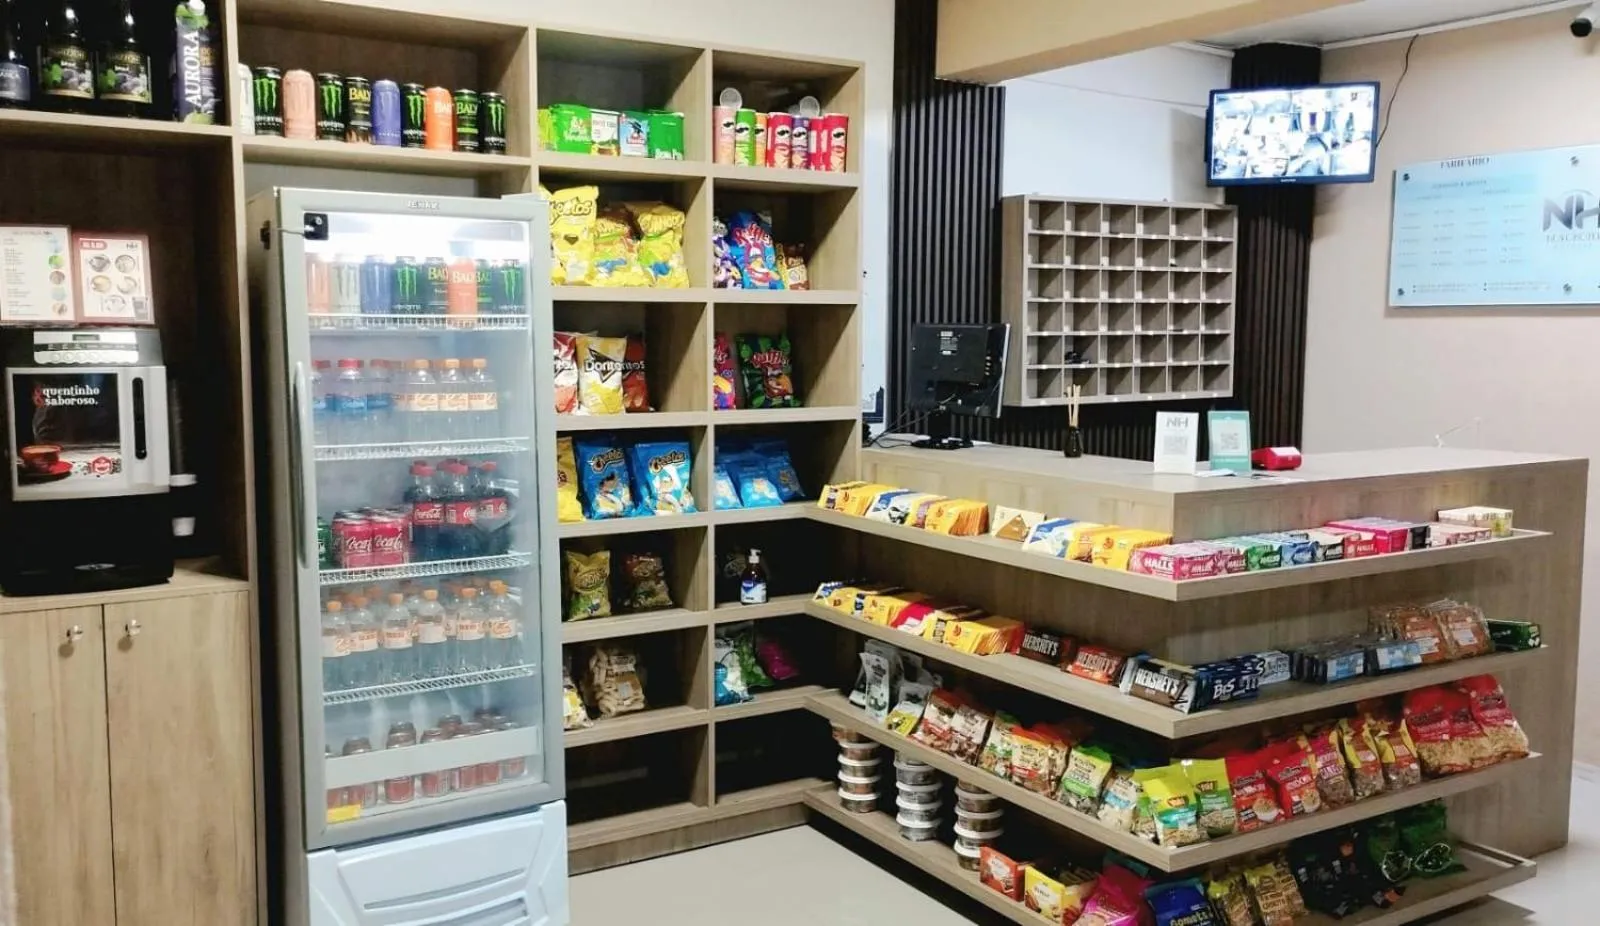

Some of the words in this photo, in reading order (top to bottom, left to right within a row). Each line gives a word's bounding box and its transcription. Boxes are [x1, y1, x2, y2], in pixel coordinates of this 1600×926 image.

[182, 31, 200, 107] AURORA
[456, 101, 478, 115] BALY
[42, 385, 100, 398] quentinho
[44, 396, 99, 406] saboroso.
[1166, 417, 1188, 428] NH
[1143, 556, 1174, 572] HALLS
[1022, 633, 1059, 656] HERSHEY'S
[1077, 651, 1118, 675] HERSHEY'S
[1135, 667, 1180, 698] HERSHEY'S
